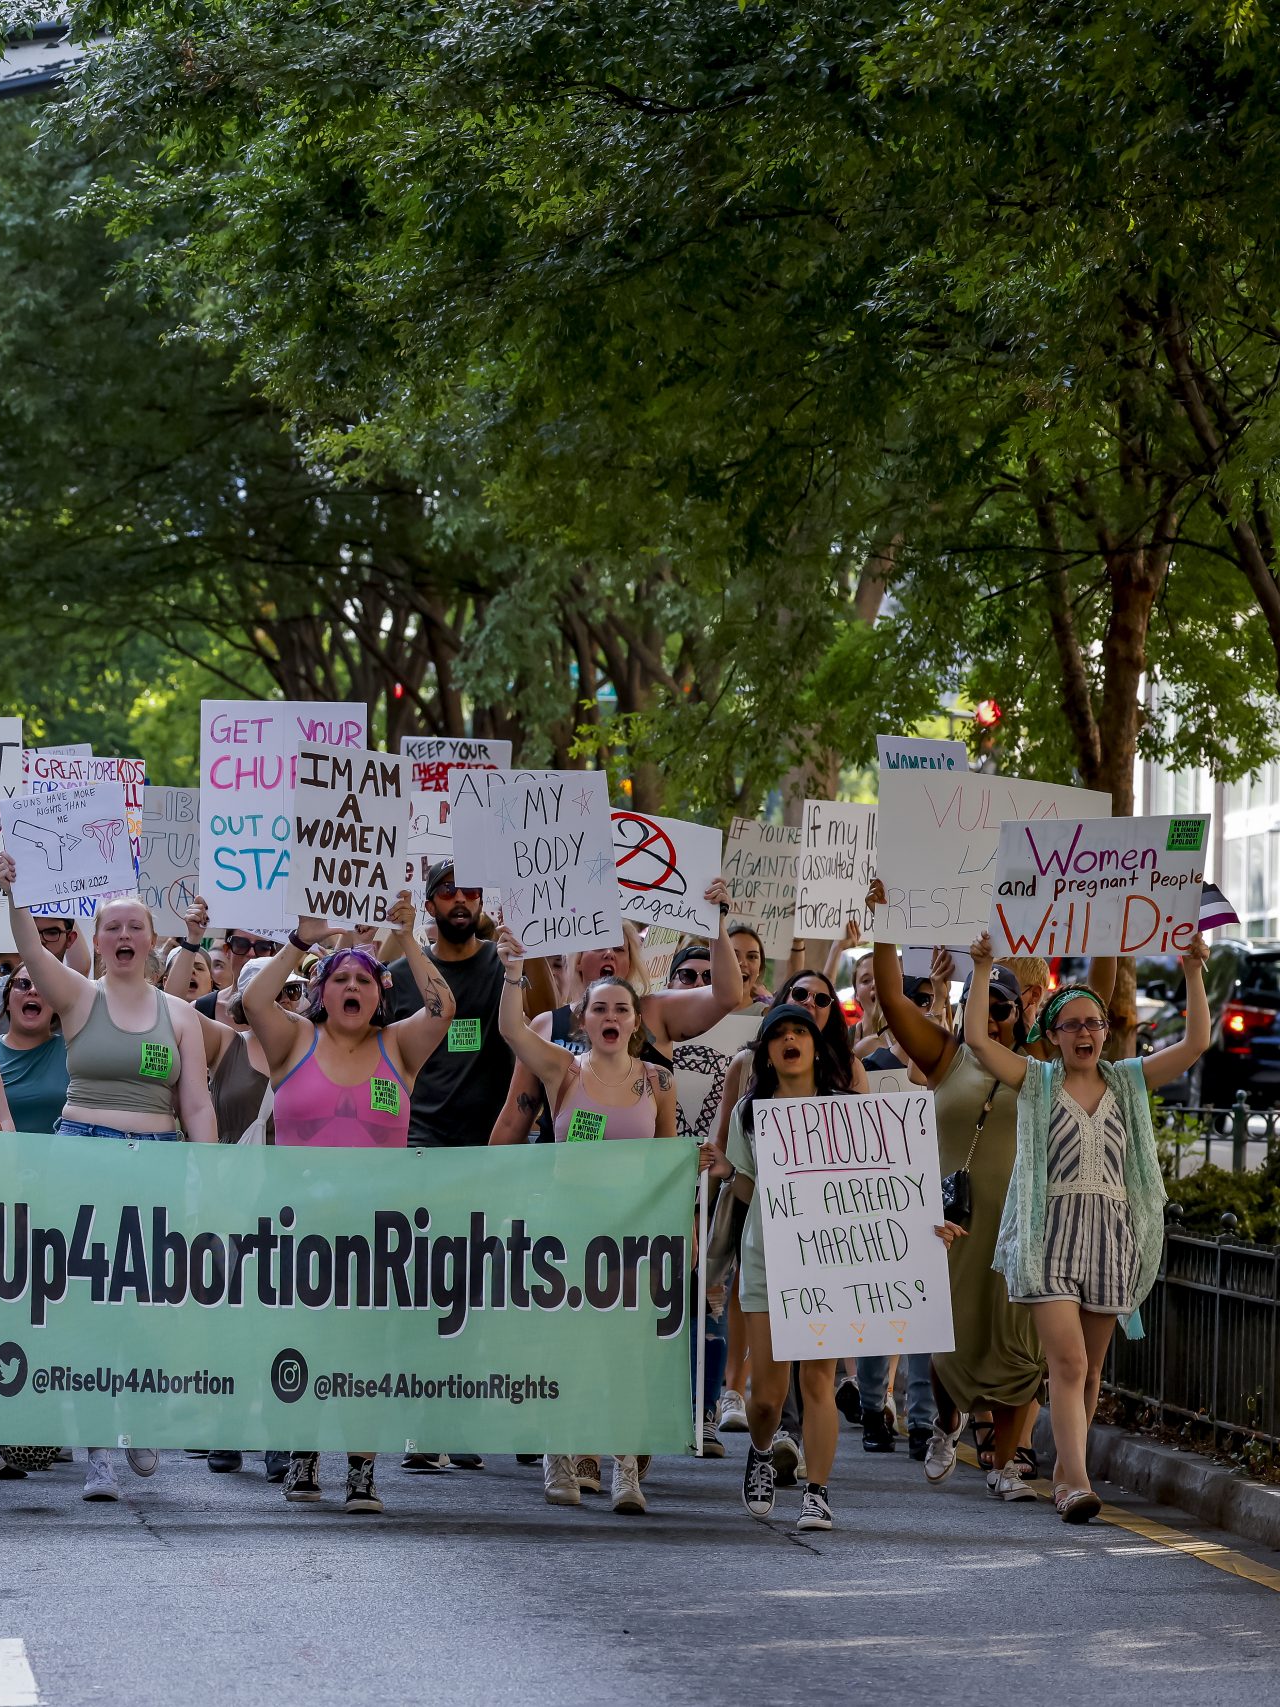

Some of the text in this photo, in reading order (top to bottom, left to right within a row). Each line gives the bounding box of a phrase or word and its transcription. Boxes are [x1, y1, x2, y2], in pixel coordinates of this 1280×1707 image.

[210, 713, 363, 749] GET YOUR
[406, 740, 491, 761] KEEP YOUR
[117, 758, 145, 786] KIDS
[359, 759, 402, 799] AM
[13, 788, 96, 810] GUNS HAVE MORE
[36, 799, 87, 817] RIGHTS THAN
[336, 793, 363, 824] A
[523, 783, 564, 829] MY
[57, 815, 69, 825] ME
[210, 814, 291, 842] OUT O
[296, 816, 397, 858] WOMEN
[729, 818, 803, 844] IF YOU'RE
[807, 805, 822, 848] If
[828, 820, 859, 860] my
[513, 832, 584, 879] BODY
[802, 851, 854, 882] assaulted
[1025, 823, 1158, 877] Women
[88, 875, 109, 887] 2022
[313, 856, 389, 891] NOT A
[998, 874, 1037, 898] and
[1053, 869, 1139, 901] pregnant
[304, 887, 389, 923] WOMB
[531, 874, 567, 915] MY
[761, 903, 791, 920] HAVE
[798, 887, 862, 931] forced to
[521, 910, 610, 947] CHOICE
[621, 895, 710, 931] again
[996, 894, 1194, 955] Will Die
[451, 1019, 477, 1027] ABORTION
[576, 1110, 603, 1122] ABORTION
[571, 1130, 599, 1141] APOLOGY!
[766, 1173, 926, 1219] WE ALREADY
[797, 1218, 909, 1267] MARCHED
[780, 1279, 927, 1319] FOR THIS!
[32, 1364, 235, 1399] @RiseUp4Abortion
[313, 1371, 560, 1405] @Rise4AbortionRights
